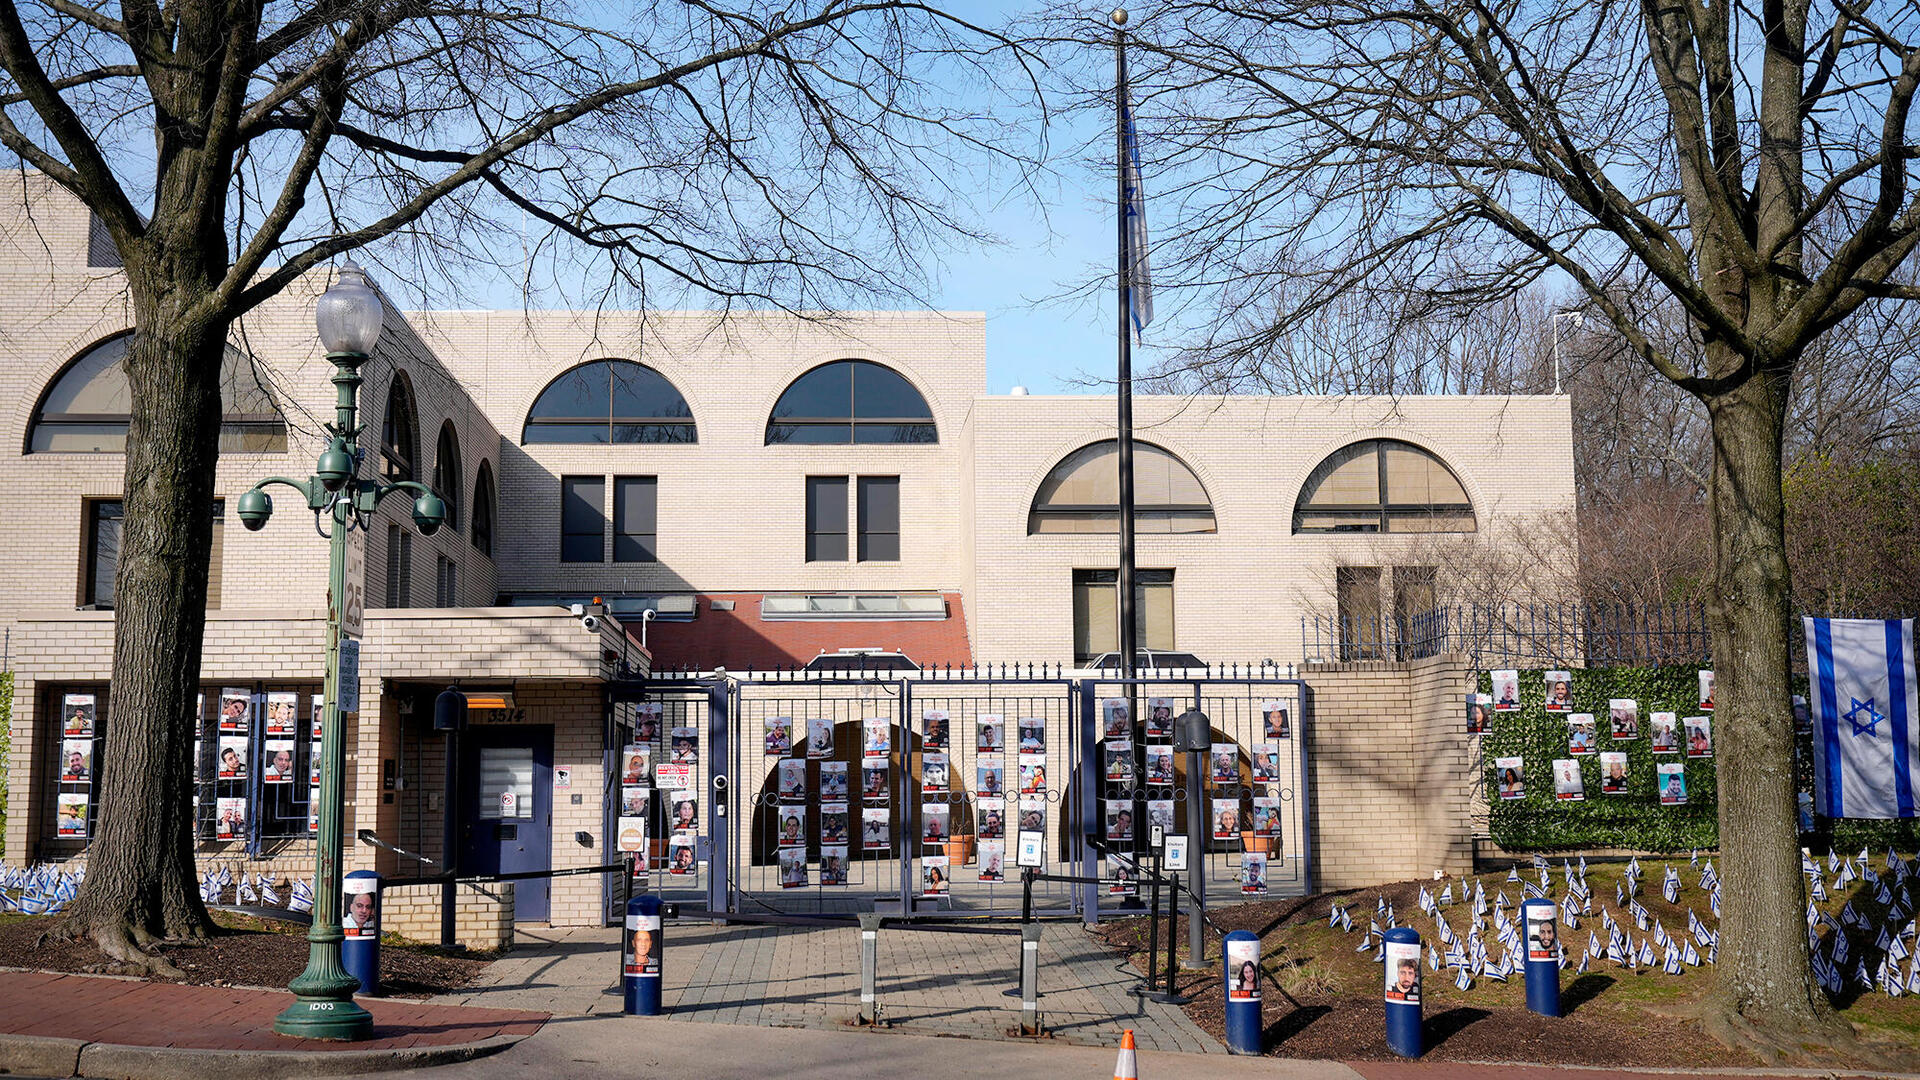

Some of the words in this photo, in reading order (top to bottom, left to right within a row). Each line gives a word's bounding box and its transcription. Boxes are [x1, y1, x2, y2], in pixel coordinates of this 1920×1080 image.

[347, 531, 363, 553] SPEED
[347, 555, 362, 578] LIMIT
[346, 582, 362, 627] 25
